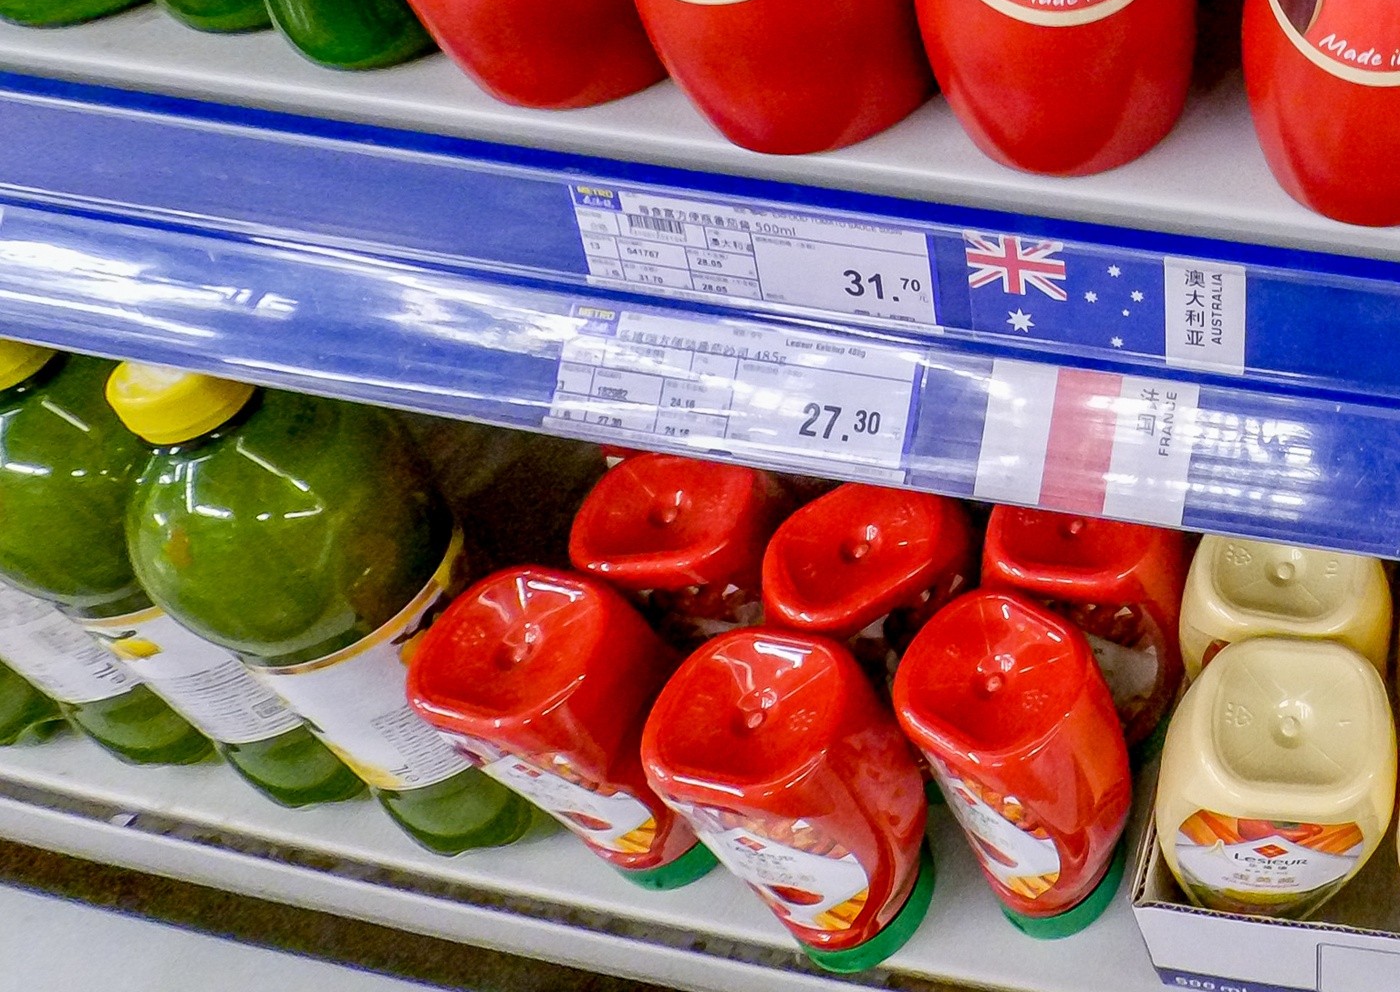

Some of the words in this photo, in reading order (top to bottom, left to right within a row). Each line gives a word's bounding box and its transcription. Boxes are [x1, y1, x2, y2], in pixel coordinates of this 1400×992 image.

[1319, 32, 1383, 67] Made
[755, 222, 796, 237] 500ml
[843, 269, 921, 303] 31.70
[1184, 269, 1206, 348] 澳大利亚
[1211, 273, 1224, 345] AUSTRALIA
[799, 402, 881, 442] 27.30
